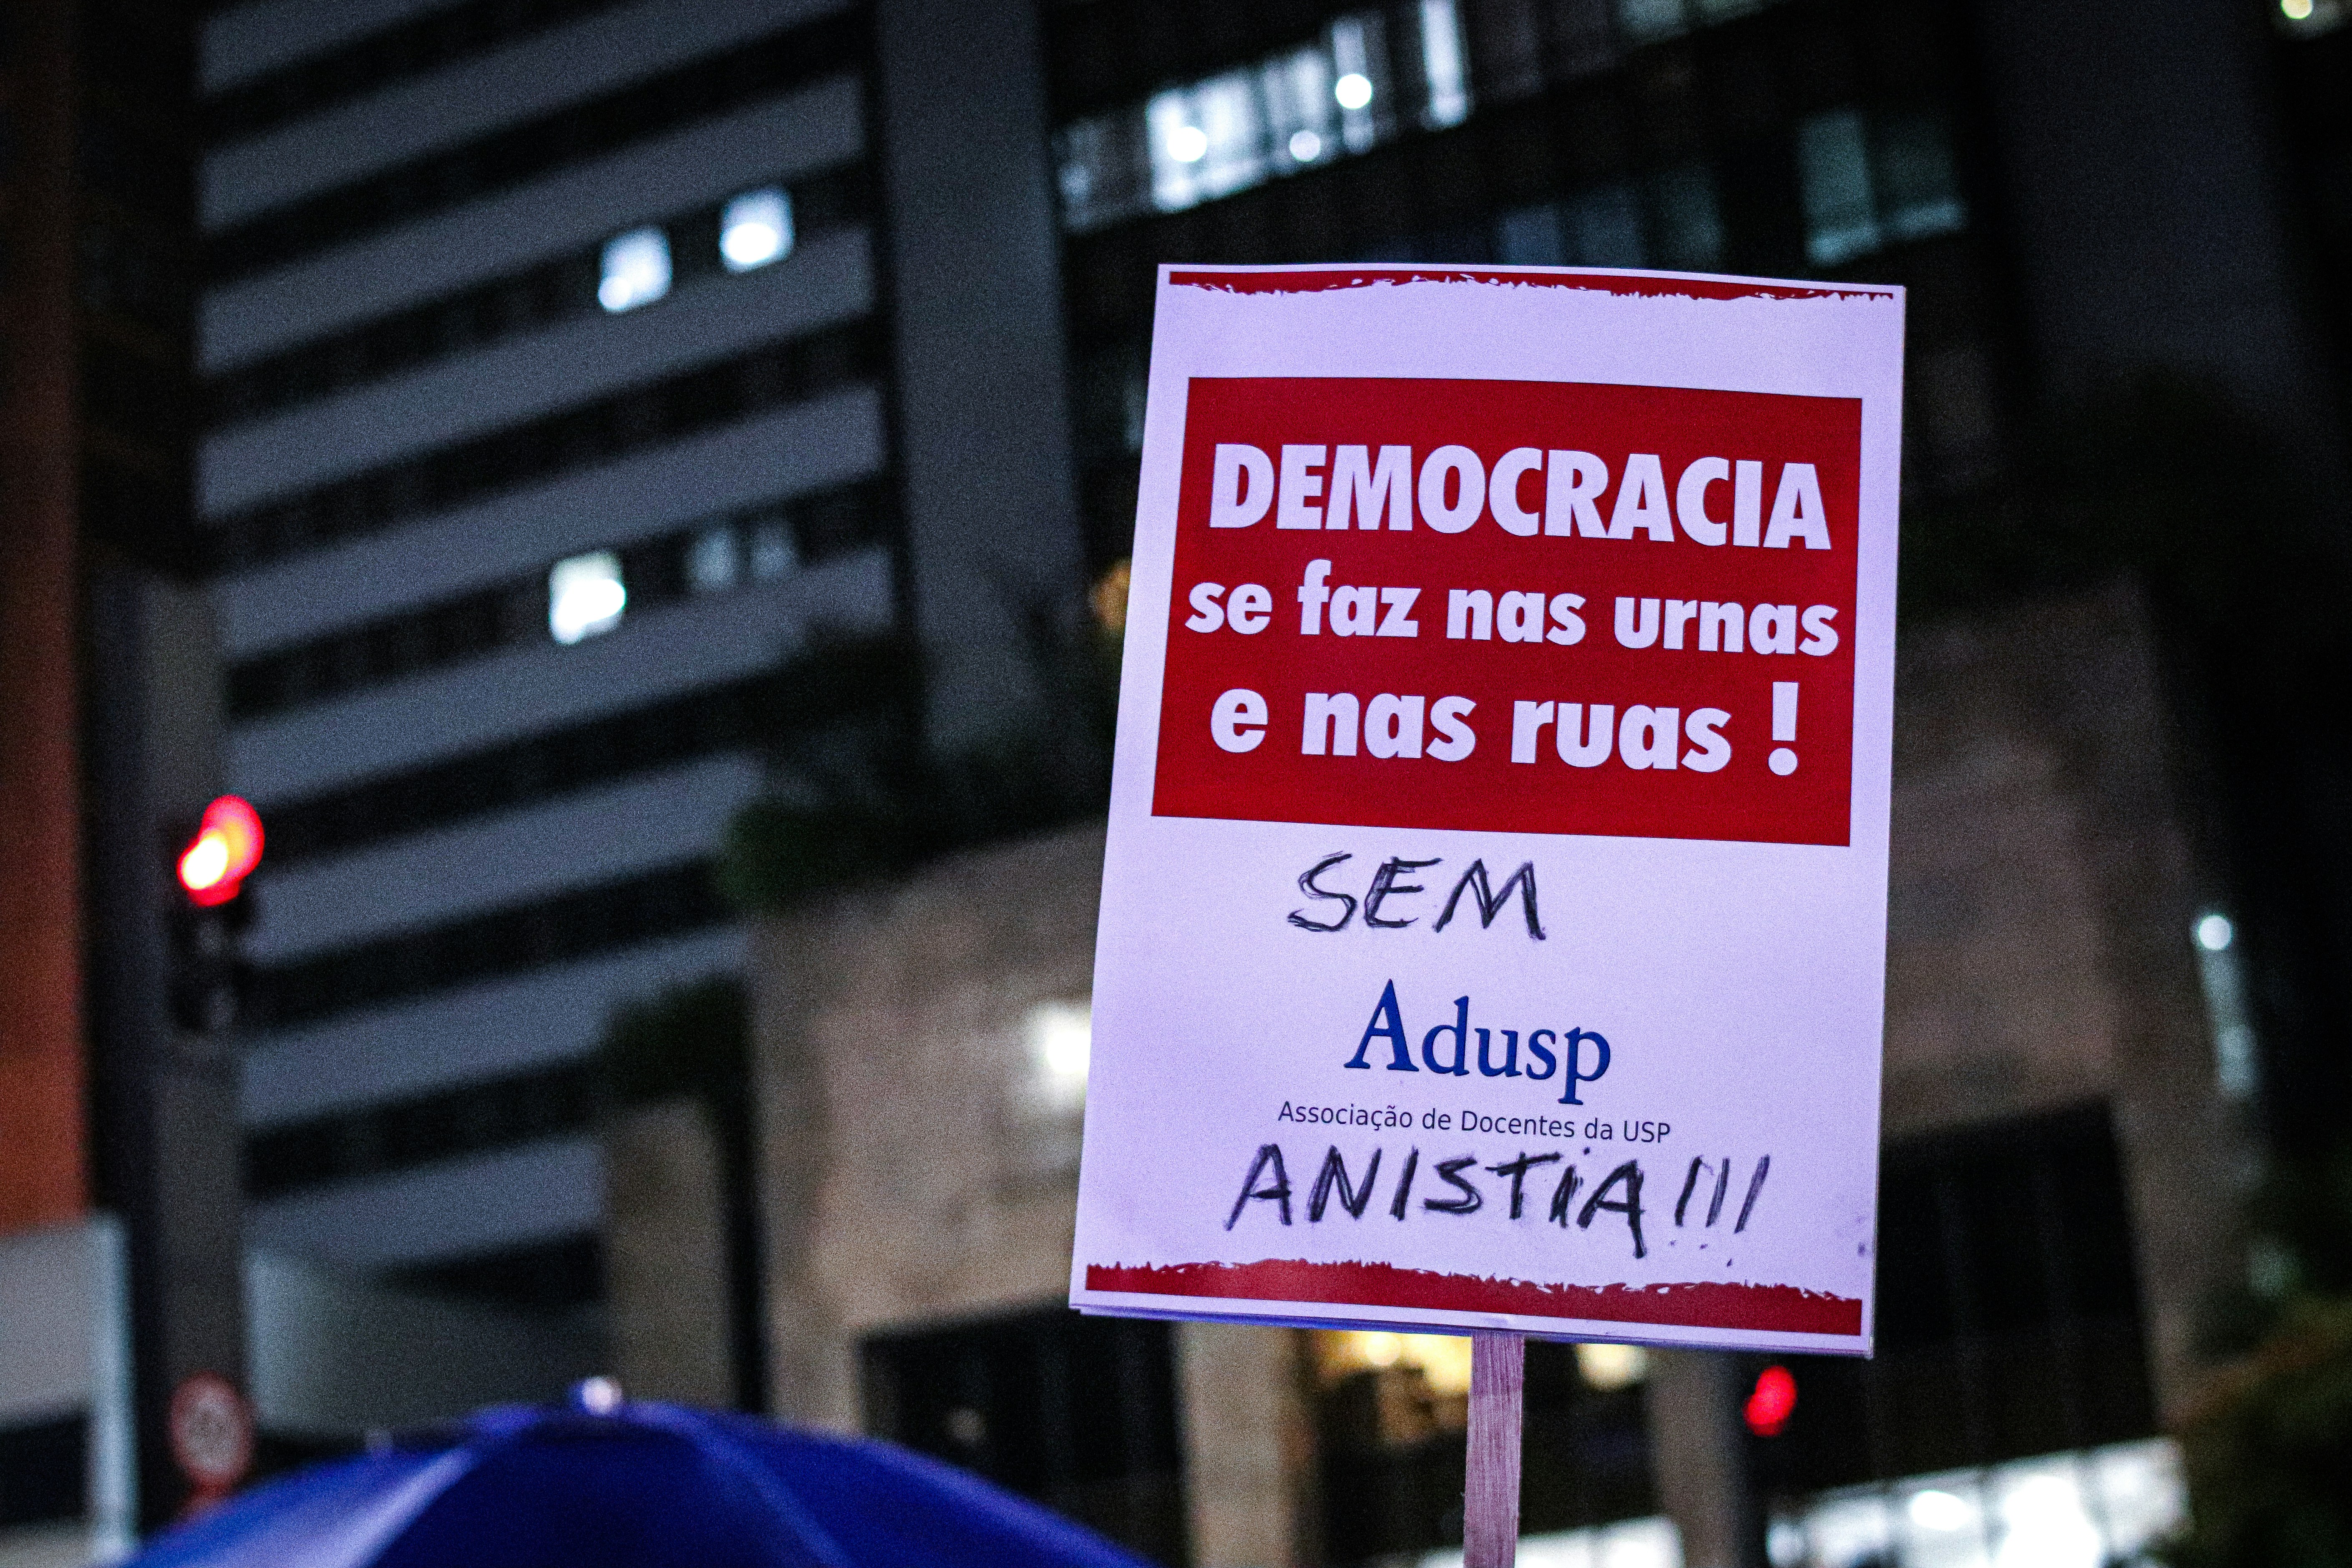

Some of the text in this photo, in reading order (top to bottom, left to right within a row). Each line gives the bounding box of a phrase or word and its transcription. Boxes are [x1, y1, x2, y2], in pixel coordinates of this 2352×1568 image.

[1209, 443, 1832, 550] DEMOCRACIA
[1184, 558, 1839, 656] se faz nas urnas
[1210, 681, 1799, 776] e nas ruas !
[1285, 850, 1547, 941] SEM
[1342, 978, 1611, 1106] Adusp
[1277, 1100, 1671, 1144] Associação de Docentes da USP
